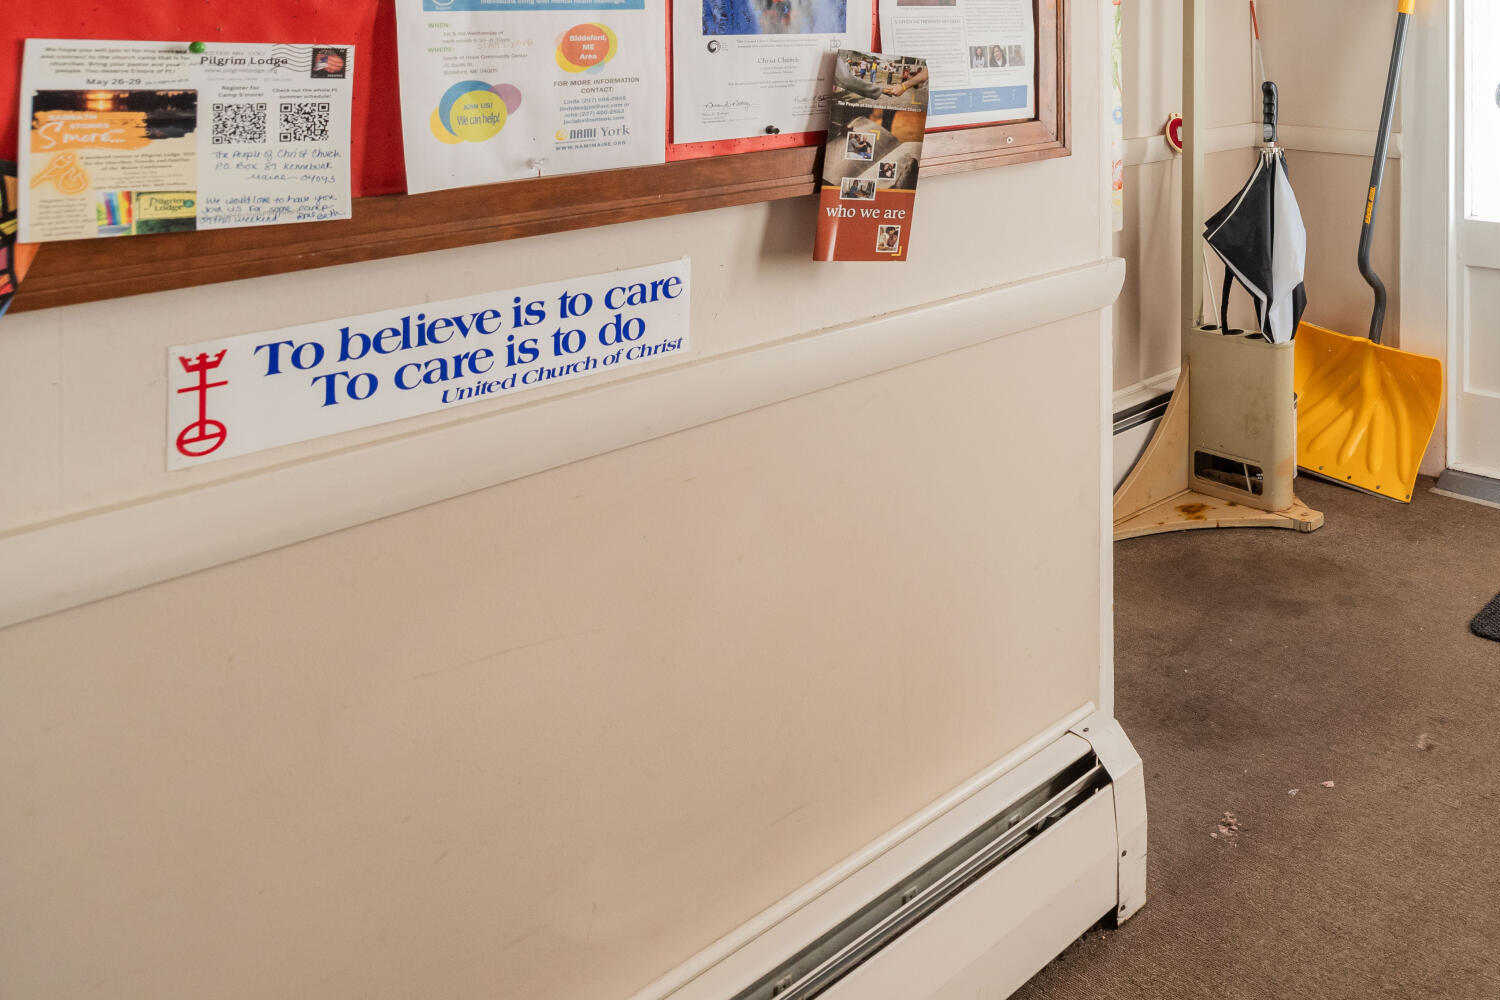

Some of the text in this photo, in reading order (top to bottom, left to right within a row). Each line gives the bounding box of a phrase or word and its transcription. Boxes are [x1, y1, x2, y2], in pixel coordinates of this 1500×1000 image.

[200, 56, 289, 68] Pilgrim Lodge
[579, 52, 598, 61] Area
[86, 77, 108, 86] May
[593, 76, 640, 85] INFORMATION
[456, 114, 468, 126] We
[469, 116, 482, 126] can
[600, 124, 631, 138] York
[826, 203, 906, 219] who we are
[253, 275, 684, 377] To believe is to care
[310, 311, 647, 408] To care is to do
[441, 336, 685, 404] United Church of Christ
